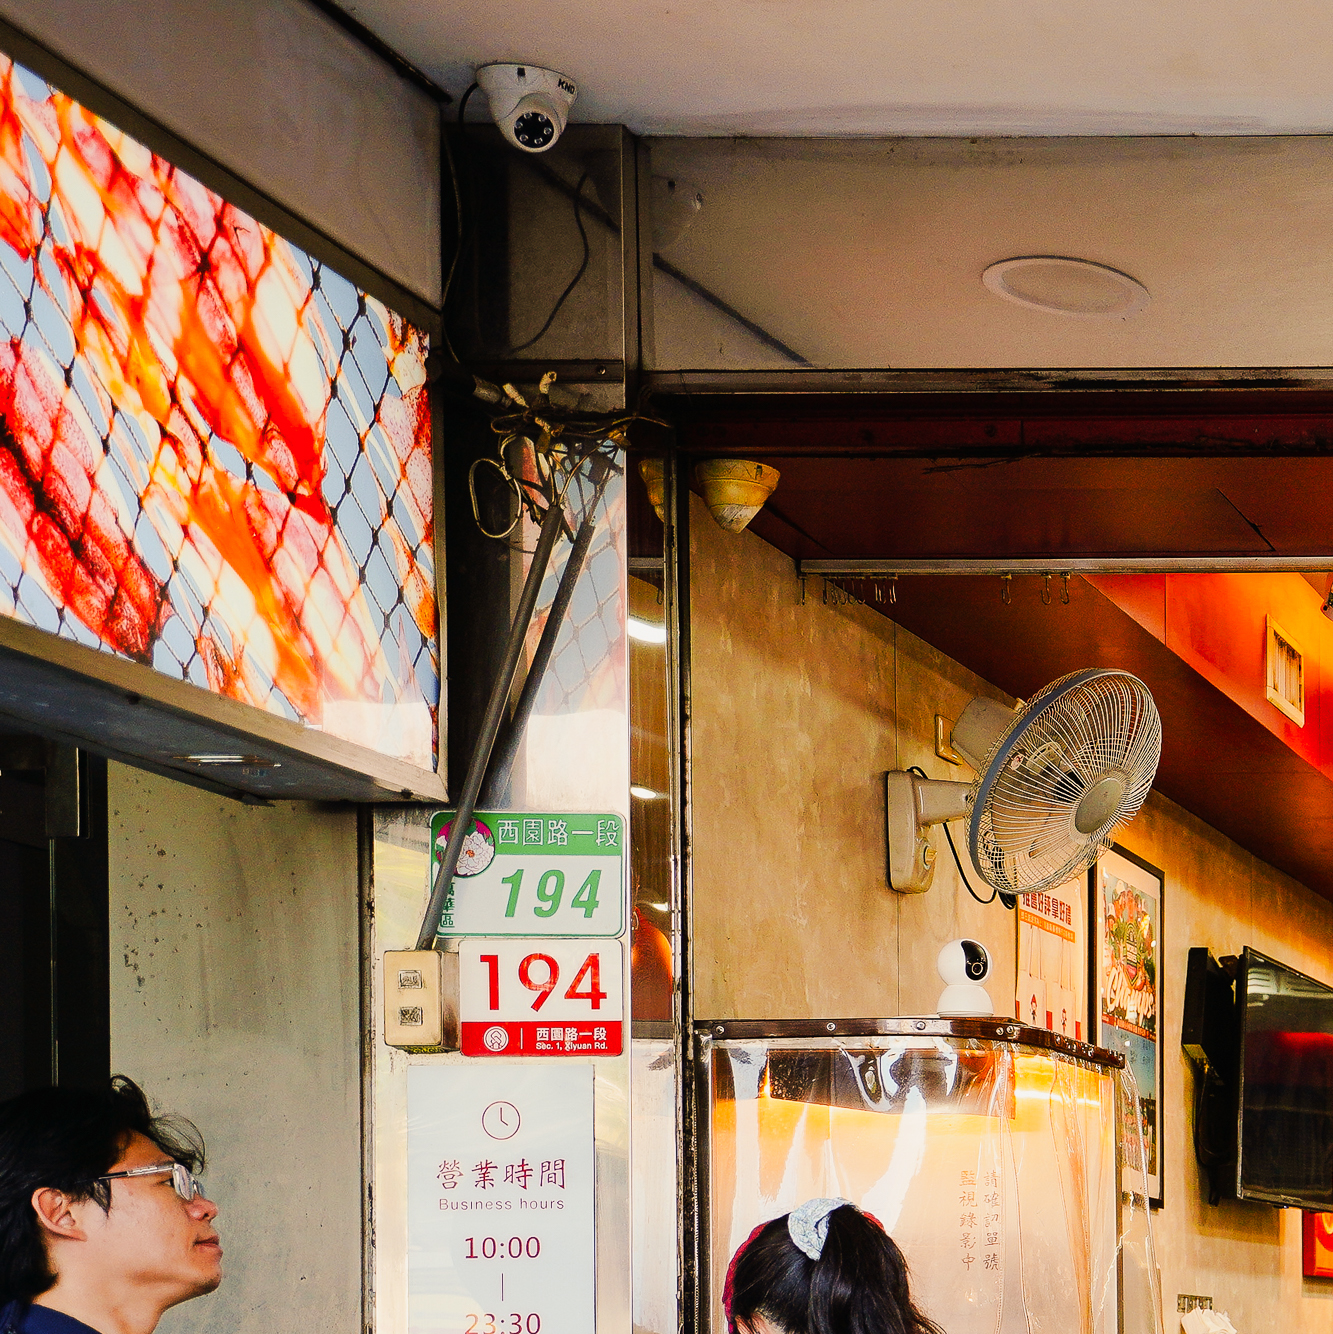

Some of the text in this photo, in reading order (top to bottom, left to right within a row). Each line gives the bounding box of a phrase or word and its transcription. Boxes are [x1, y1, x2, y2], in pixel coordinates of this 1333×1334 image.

[497, 819, 620, 847] 西園路一段
[501, 868, 602, 918] 194
[479, 952, 608, 1012] 194
[535, 1027, 608, 1041] 西園路一段
[535, 1042, 557, 1051] Sec.
[565, 1042, 592, 1054] Xiyuan
[594, 1041, 608, 1051] Rd.
[436, 1158, 566, 1190] 營業時間
[439, 1198, 565, 1211] Business hours
[959, 1170, 978, 1271] 監視錄影中
[464, 1236, 541, 1259] 10:00
